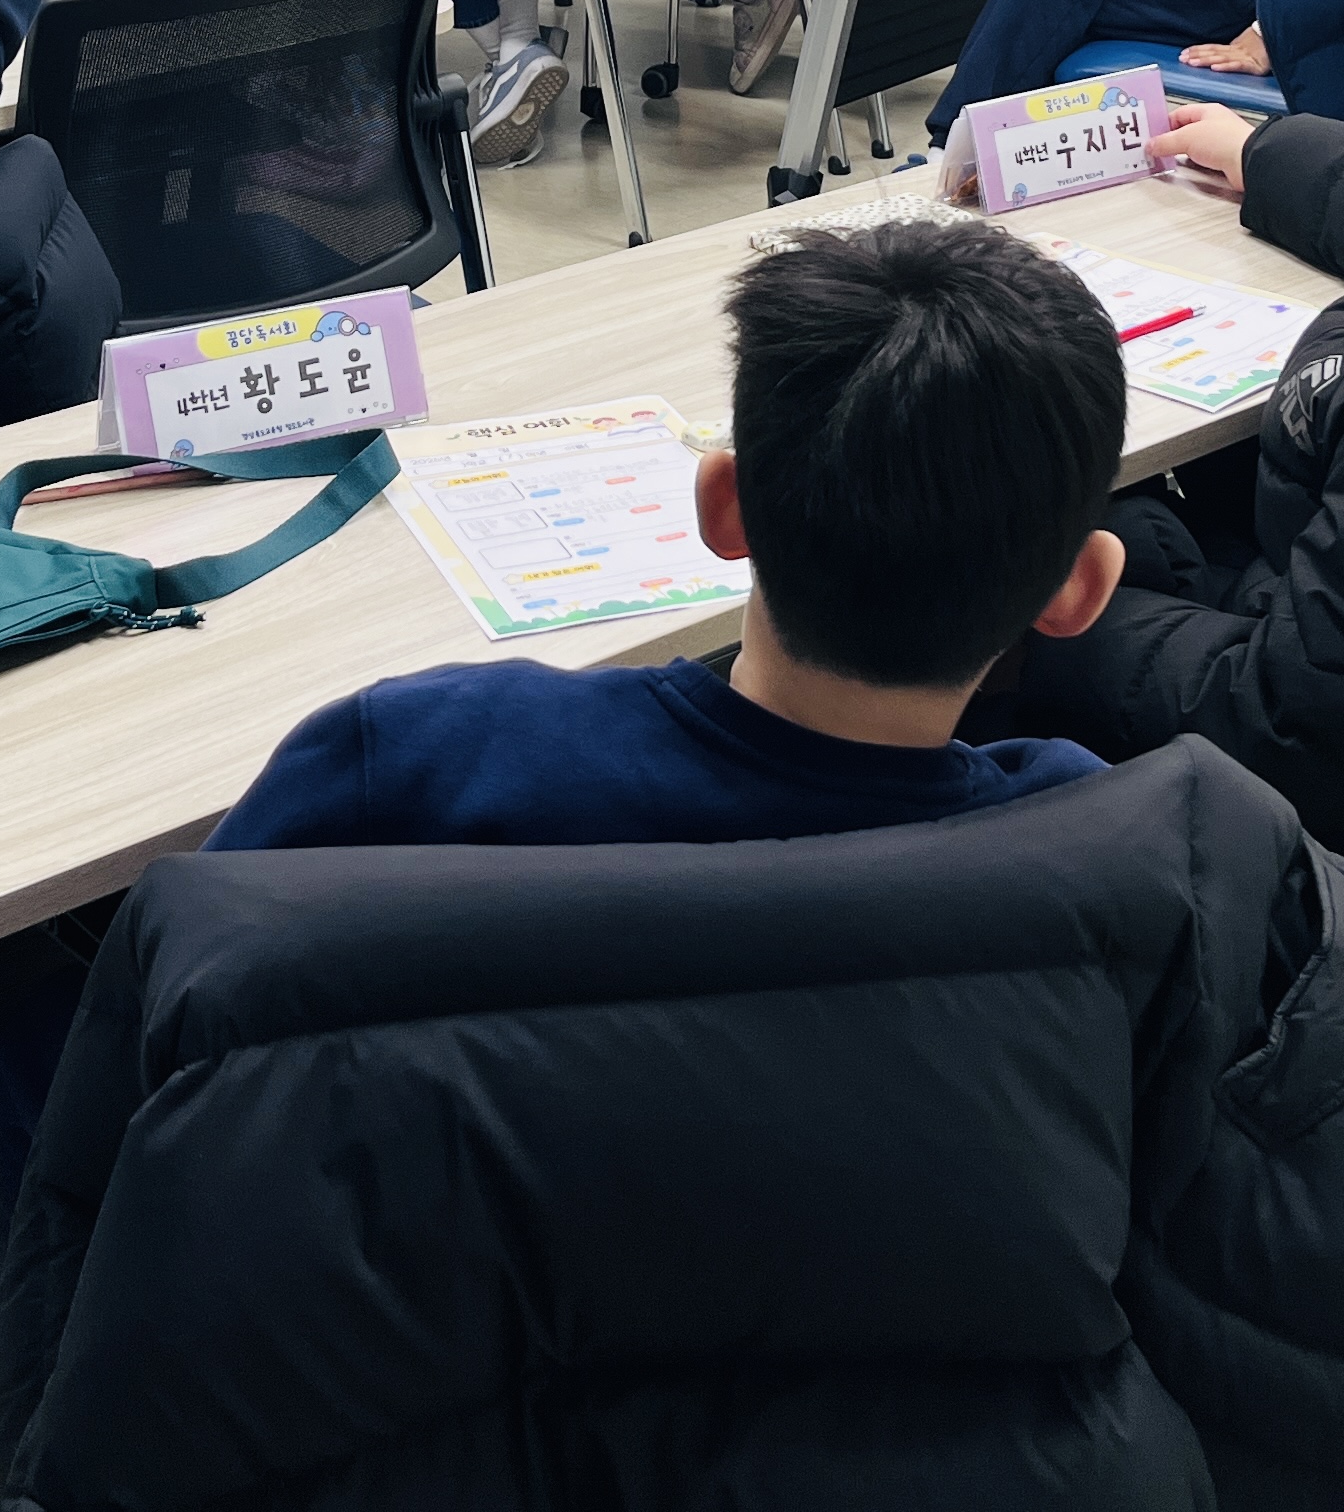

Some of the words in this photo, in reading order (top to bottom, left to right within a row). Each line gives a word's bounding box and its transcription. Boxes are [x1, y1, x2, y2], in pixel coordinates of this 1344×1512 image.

[1014, 141, 1050, 166] 4학년
[1056, 112, 1141, 169] 우지헌
[176, 384, 231, 417] 4학년
[465, 425, 517, 438] 핵심
[523, 417, 570, 429] 어휘
